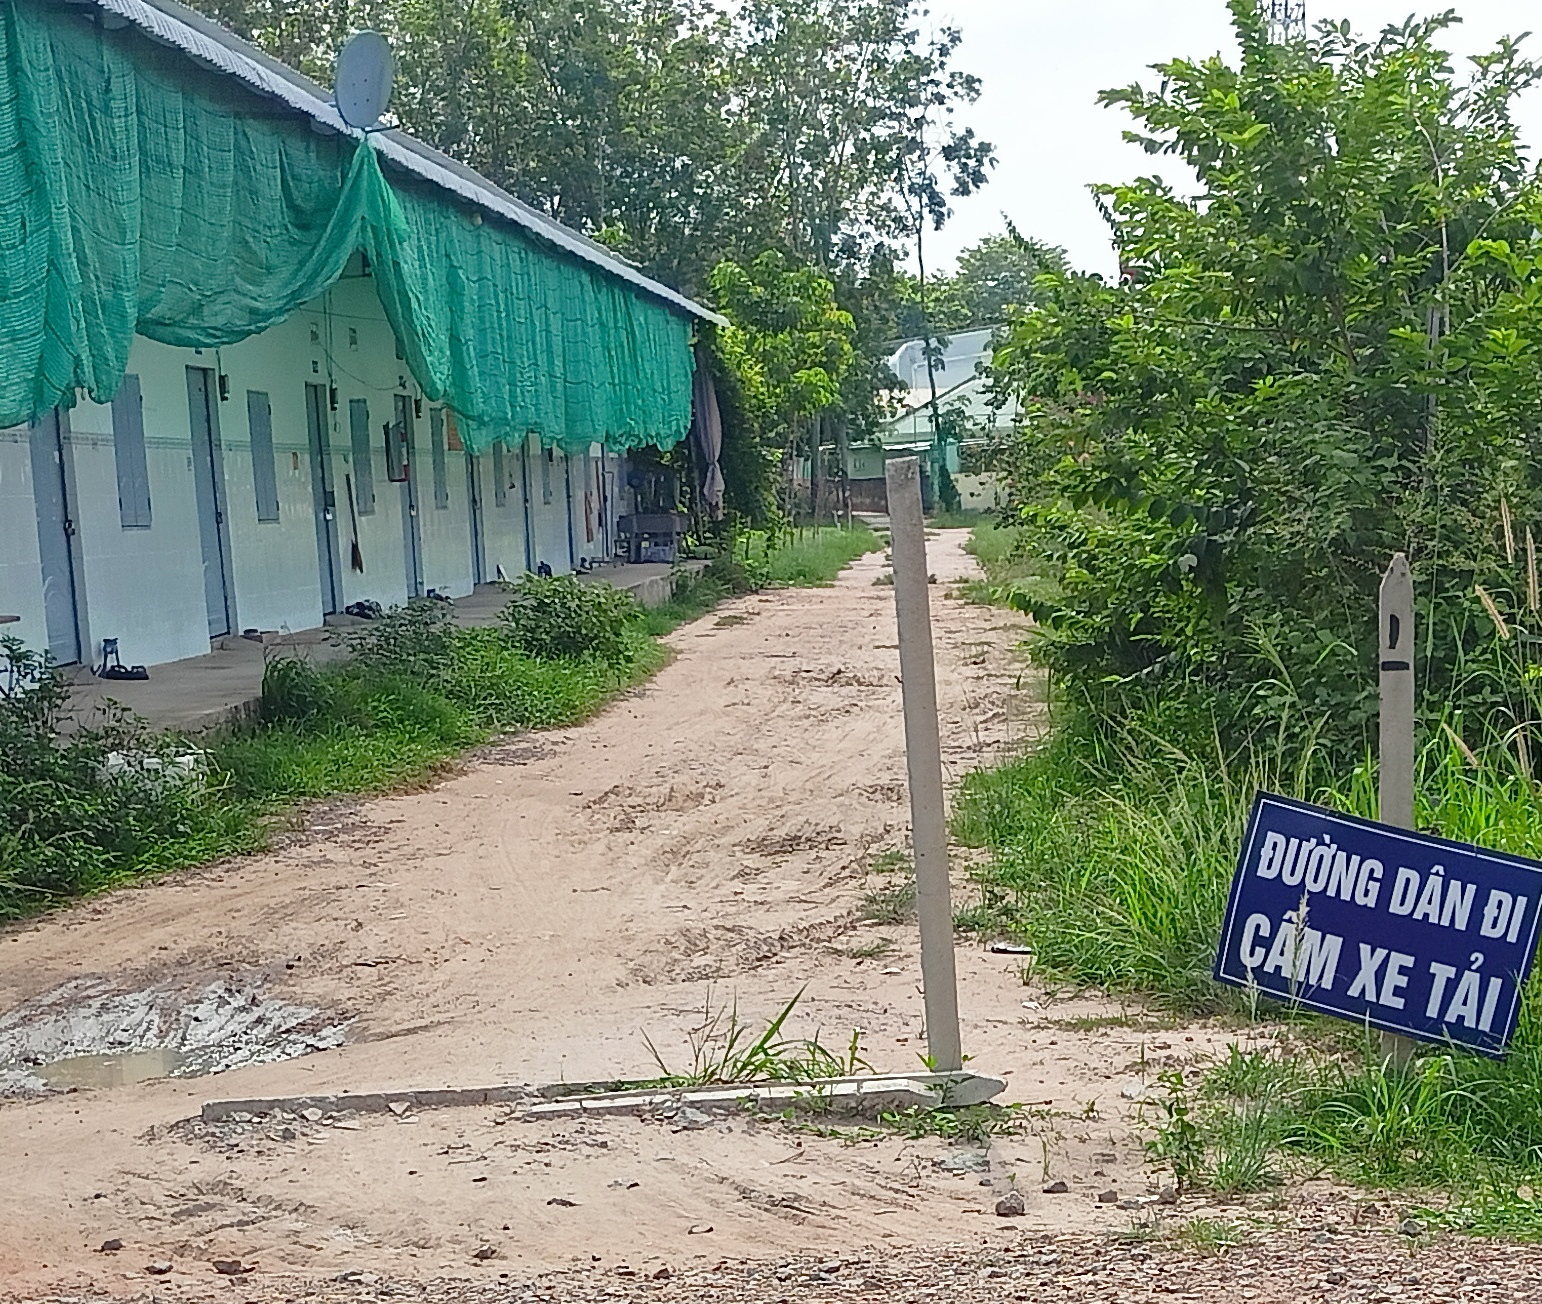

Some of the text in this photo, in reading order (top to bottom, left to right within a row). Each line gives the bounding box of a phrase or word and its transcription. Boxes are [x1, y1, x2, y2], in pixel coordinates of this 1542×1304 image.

[1256, 832, 1528, 944] ĐƯỜNG DÂN ĐI
[1346, 943, 1415, 1010] XE
[1425, 952, 1503, 1031] TẢI
